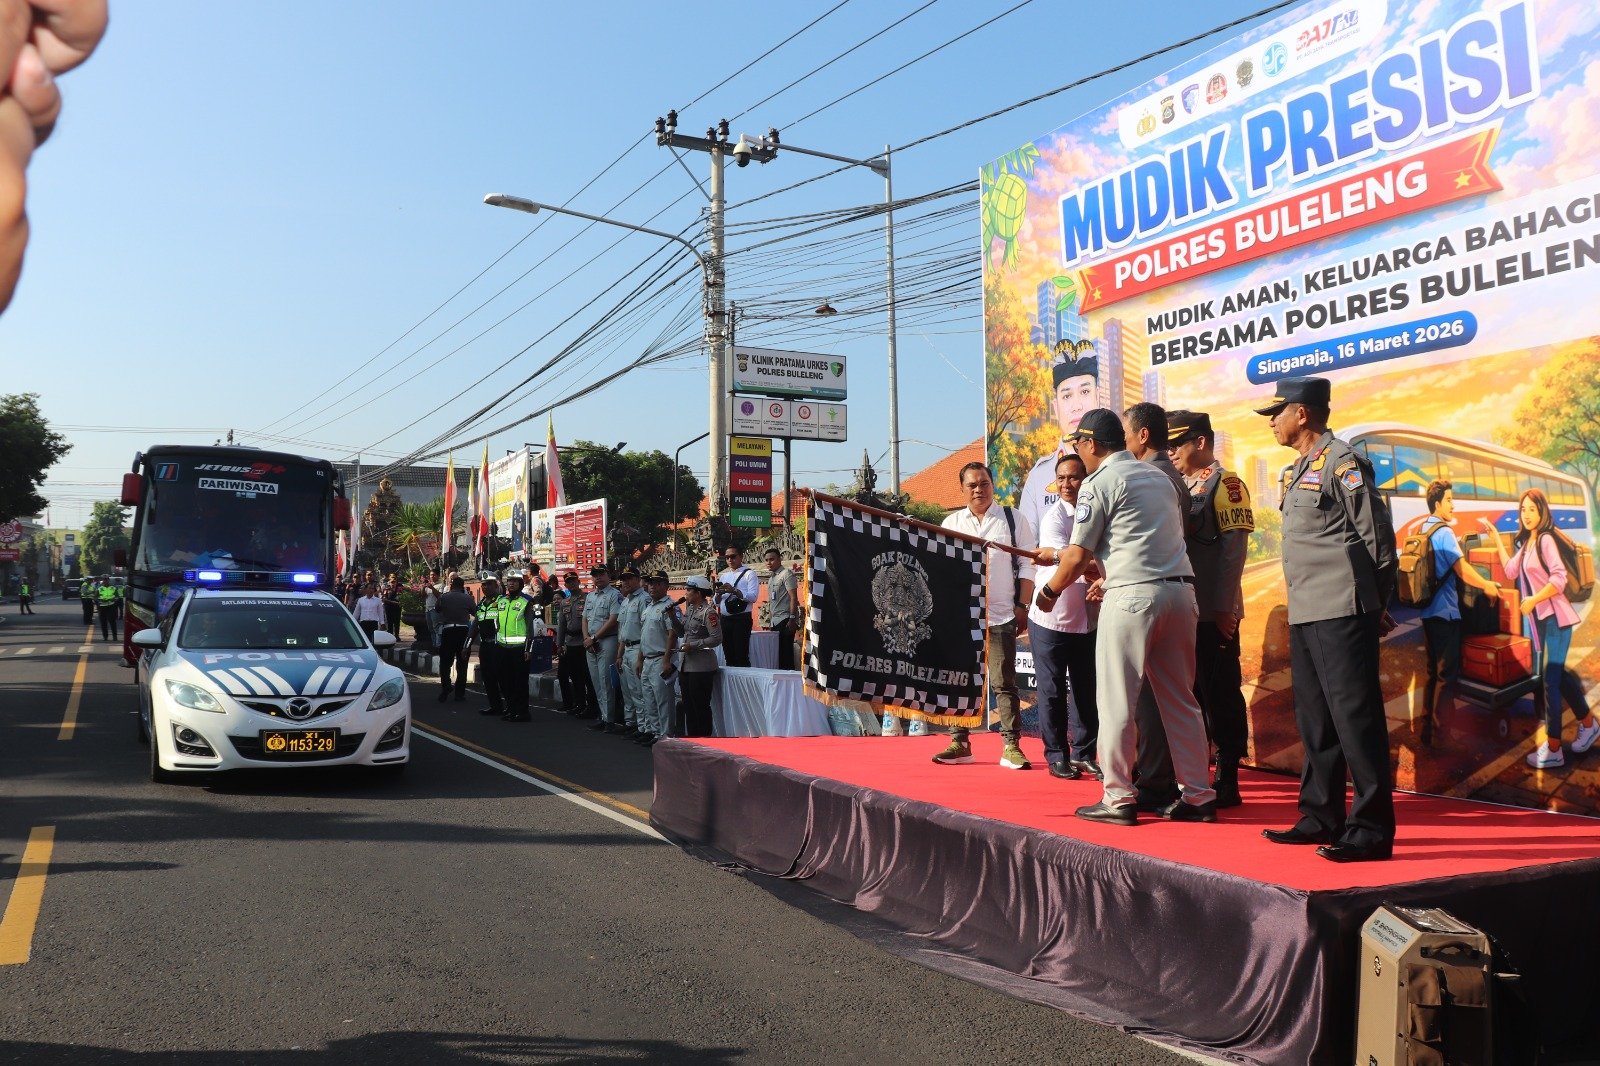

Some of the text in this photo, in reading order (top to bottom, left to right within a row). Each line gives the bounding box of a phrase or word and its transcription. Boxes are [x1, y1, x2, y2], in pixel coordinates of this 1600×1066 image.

[1062, 2, 1532, 262] MUDIK PRESISI
[1115, 160, 1428, 290] POLRES BULELENG
[1147, 300, 1215, 334] MUDIK
[1221, 279, 1298, 316] AMAN,
[1304, 235, 1457, 294] KELUARGA
[1151, 316, 1278, 365] BERSAMA
[1286, 282, 1410, 335] POLRES
[1258, 319, 1464, 376] Singaraja, 16 Maret 2026
[751, 355, 828, 370] KLINIK PRATAMA URKES
[757, 367, 823, 380] POLRES BULELENG
[736, 442, 766, 451] MELAYANI:
[194, 464, 252, 473] JETBUS
[201, 480, 276, 493] PARIWISATA
[734, 496, 748, 504] POLI
[738, 514, 763, 522] FARMASI
[1217, 509, 1230, 528] KA
[1231, 508, 1245, 524] OPS
[204, 652, 365, 664] POLISI
[830, 649, 970, 687] POLRES BULELENG
[289, 738, 333, 752] 1153-29
